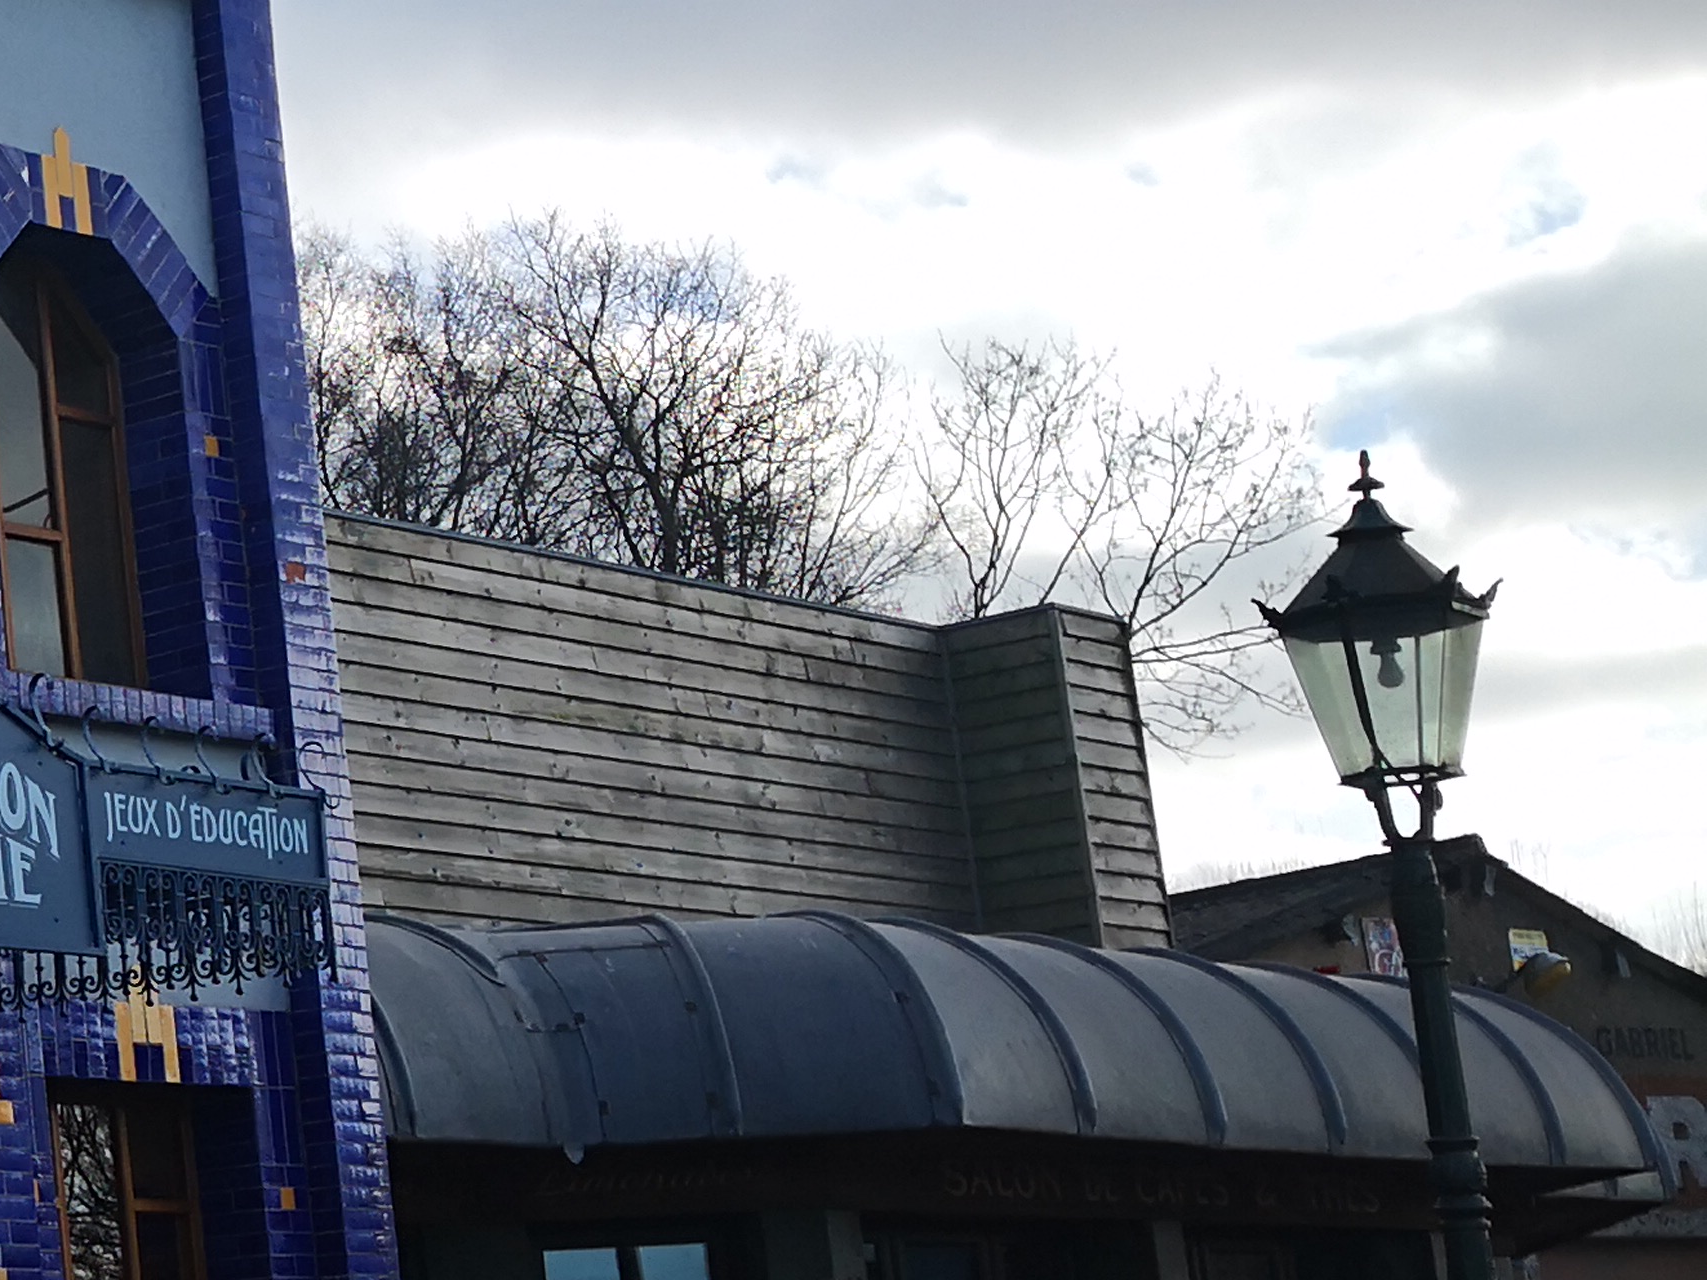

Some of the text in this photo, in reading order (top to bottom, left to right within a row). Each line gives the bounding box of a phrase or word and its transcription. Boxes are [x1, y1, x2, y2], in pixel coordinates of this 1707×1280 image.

[104, 791, 161, 842] JEUX
[1596, 1026, 1694, 1060] GABRIEL
[940, 1163, 1062, 1202] SALON
